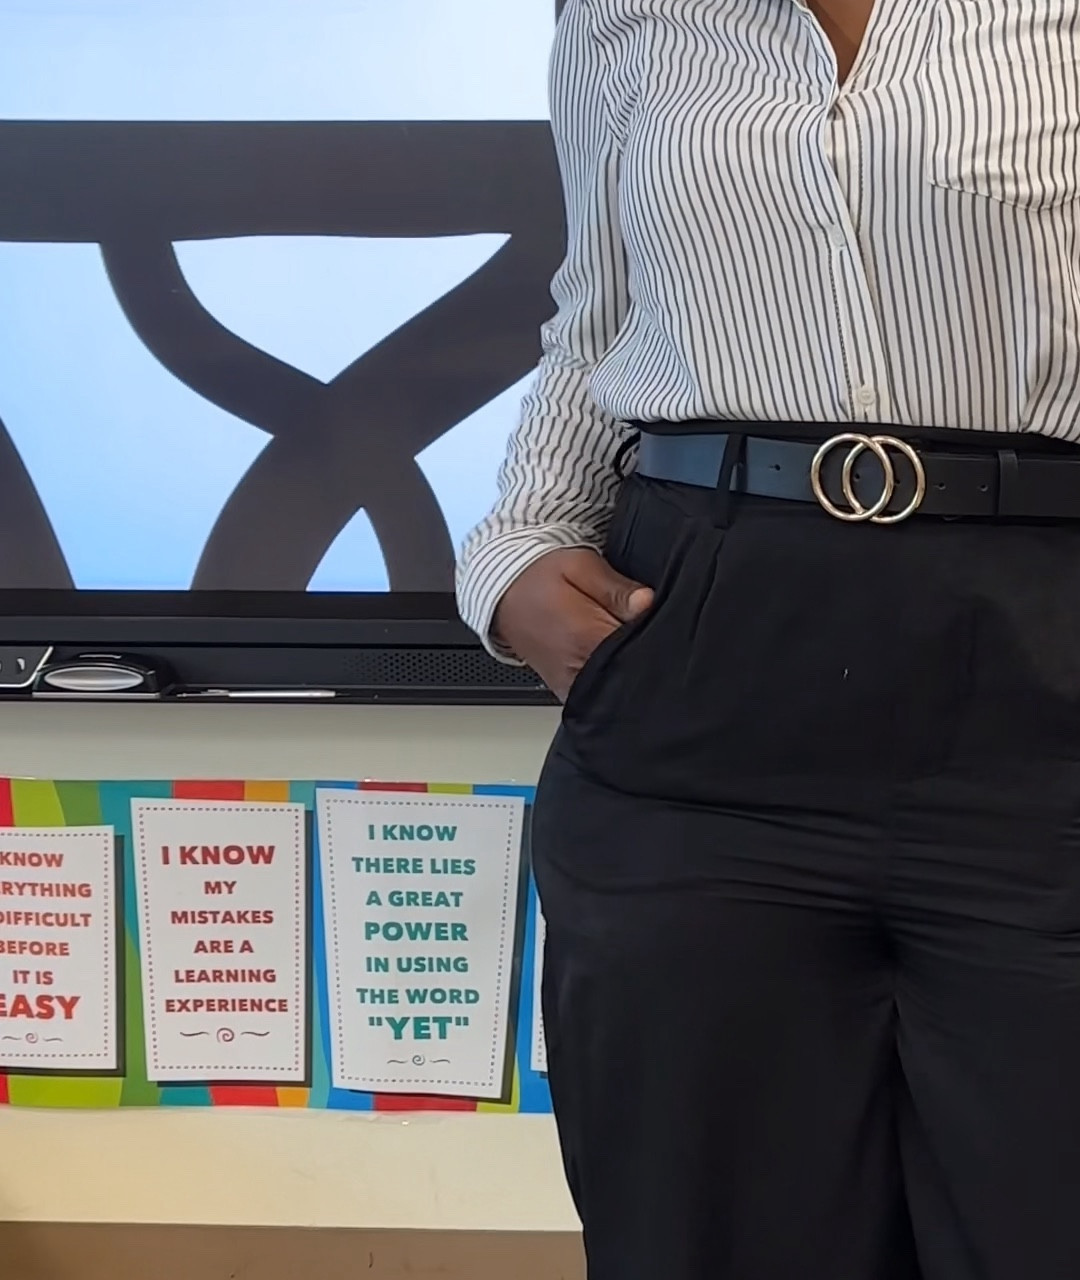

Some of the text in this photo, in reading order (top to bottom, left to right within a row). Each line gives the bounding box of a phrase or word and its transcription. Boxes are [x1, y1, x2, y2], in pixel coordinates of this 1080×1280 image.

[368, 825, 457, 841] I KNOW
[162, 845, 275, 865] I KNOW
[352, 857, 476, 876] THERE LIES
[0, 882, 92, 898] RYTHING
[204, 880, 237, 895] MY
[366, 891, 463, 907] A GREAT
[171, 910, 273, 925] MISTAKES
[364, 922, 468, 941] POWER
[194, 940, 254, 953] ARE A
[366, 956, 469, 974] IN USING
[13, 970, 53, 985] IT IS
[174, 969, 277, 984] LEARNING
[356, 988, 480, 1005] THE WORD
[165, 998, 288, 1013] EXPERIENCE
[368, 1016, 469, 1040] "YET"
